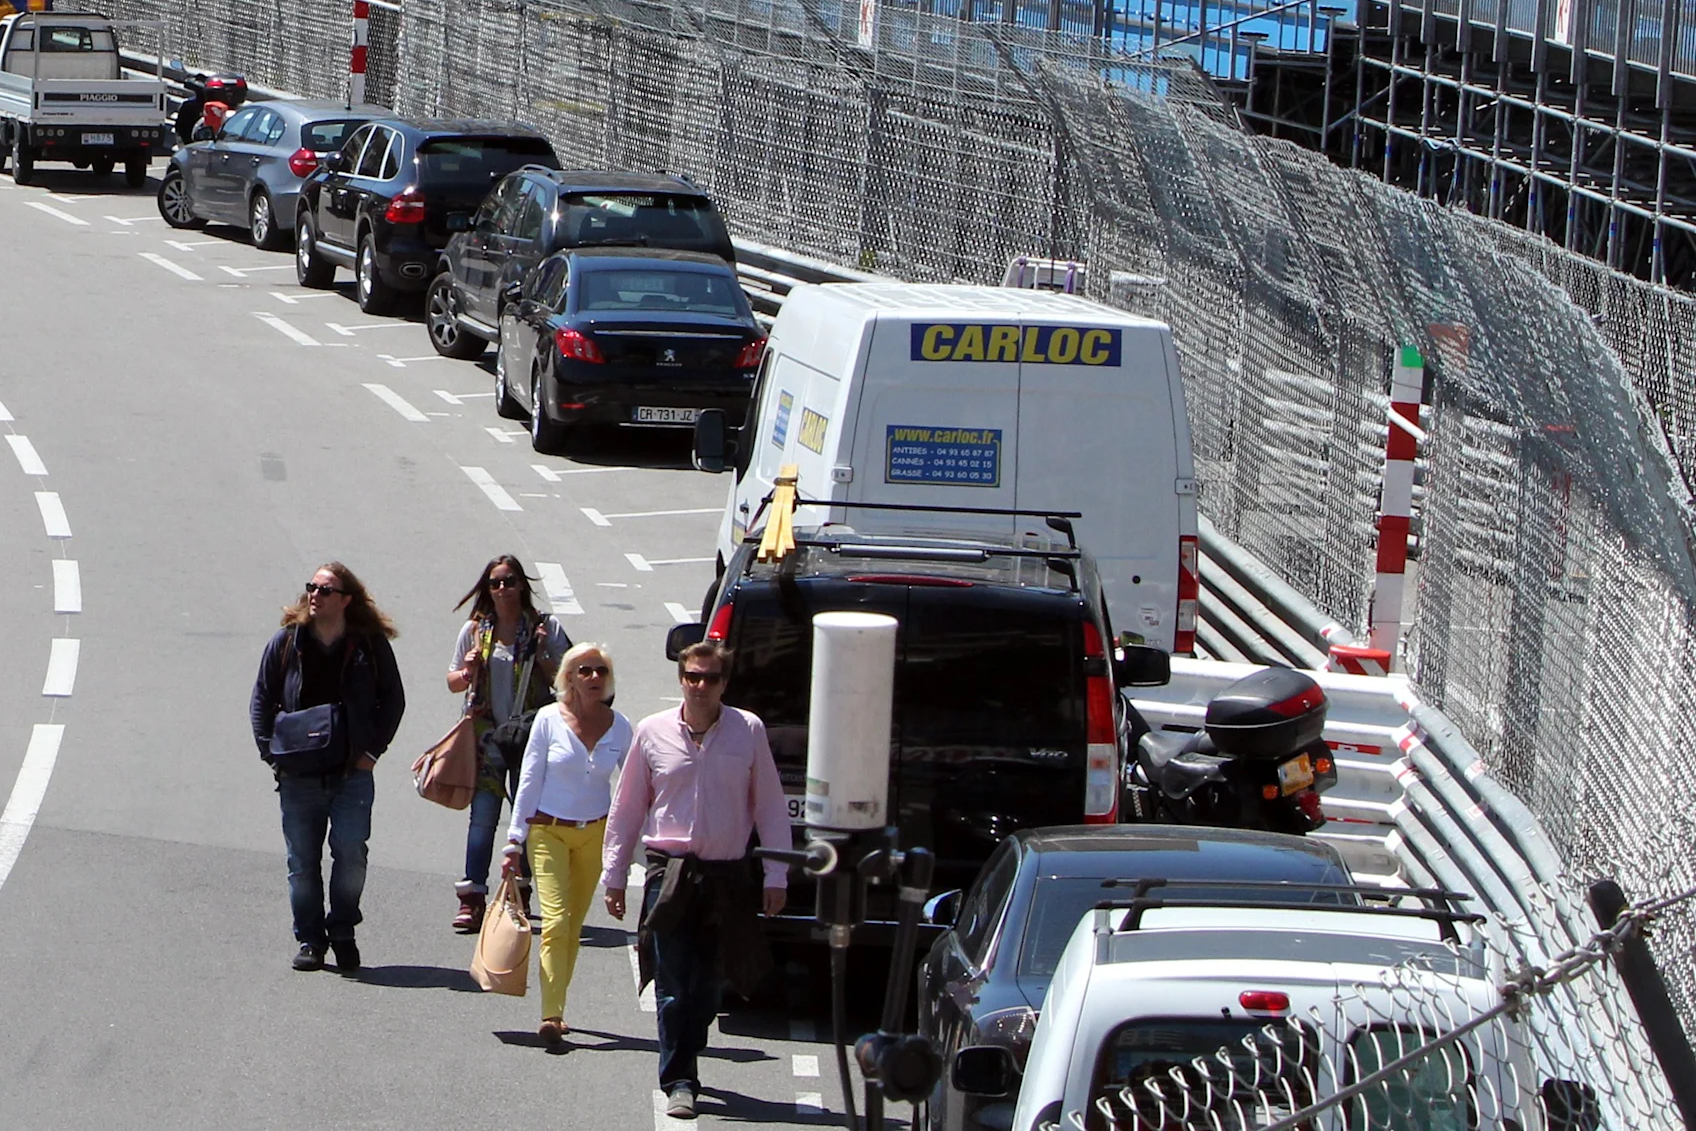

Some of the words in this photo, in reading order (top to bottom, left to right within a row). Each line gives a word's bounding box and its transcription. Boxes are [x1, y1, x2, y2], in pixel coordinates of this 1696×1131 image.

[80, 93, 118, 102] PIAGGIO
[921, 324, 1112, 365] CARLOC
[894, 429, 995, 445] www.carloc.fr
[892, 446, 928, 455] ANTIBES
[892, 457, 924, 465] CANNES
[891, 469, 922, 477] GRASSE
